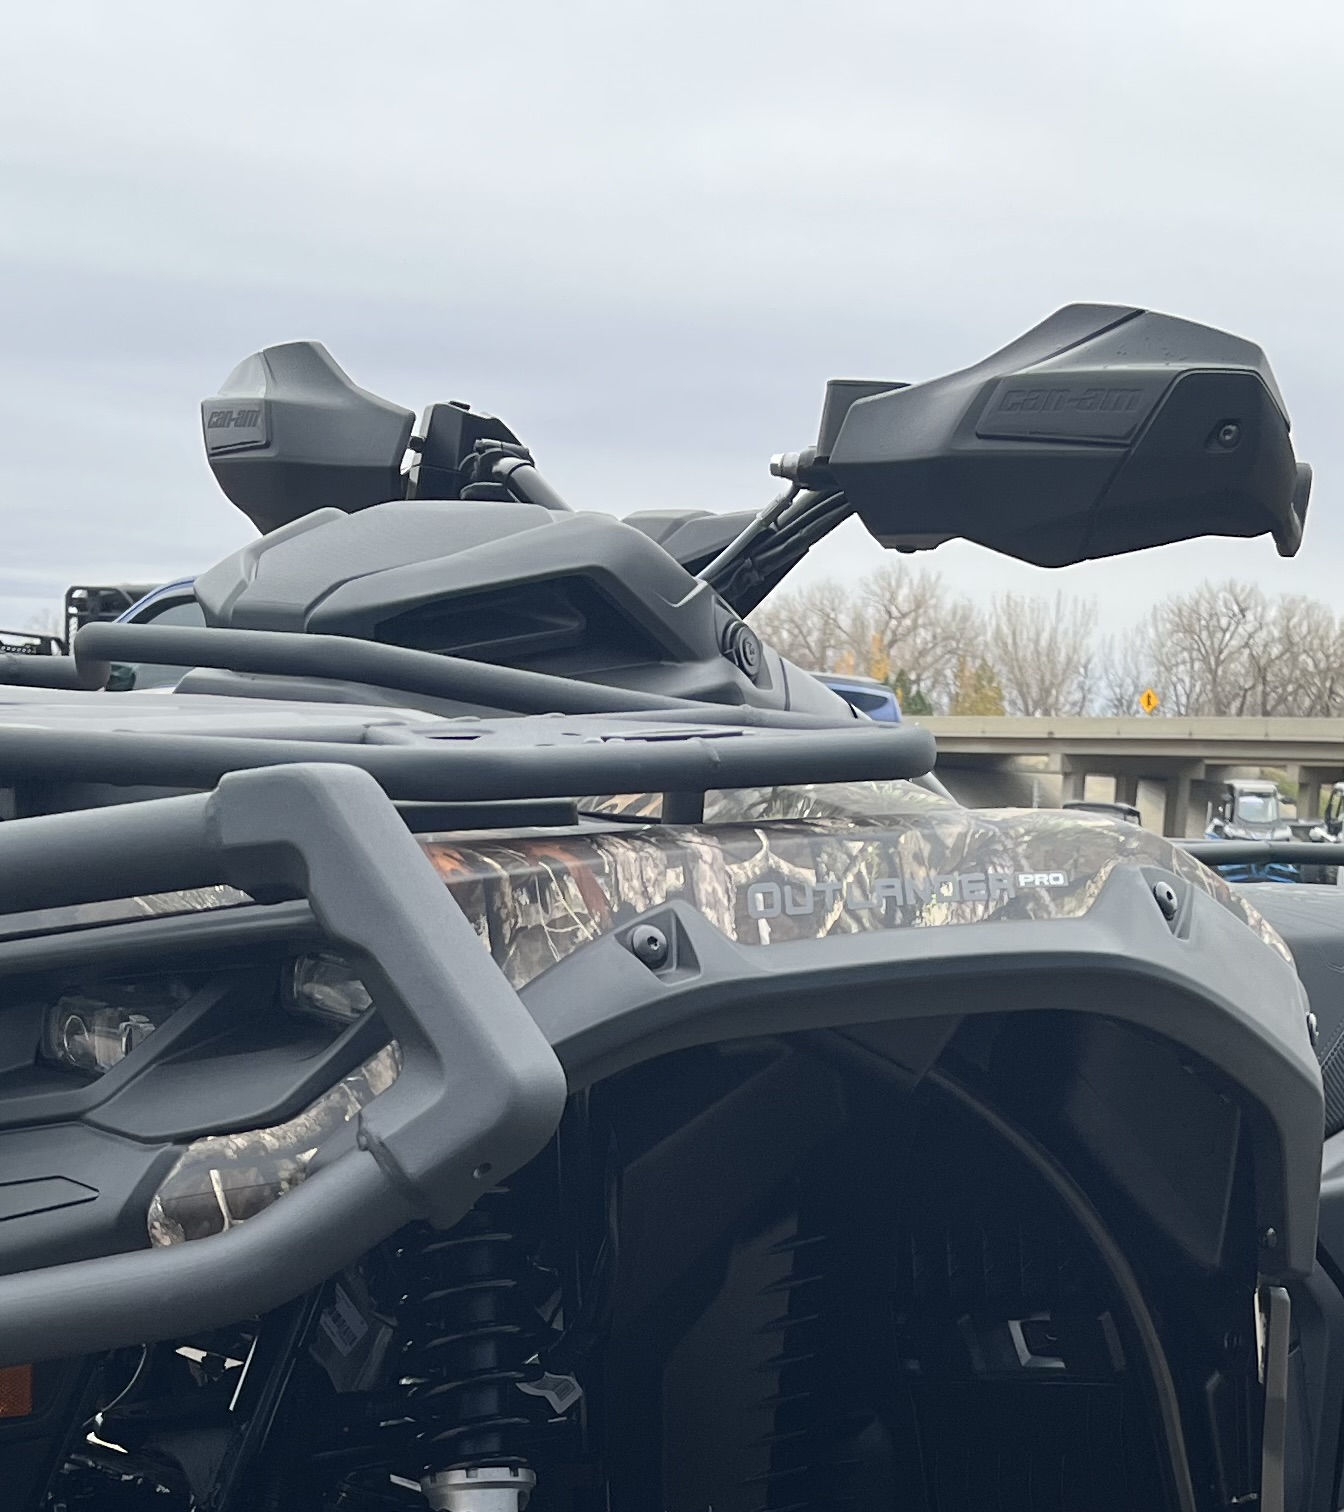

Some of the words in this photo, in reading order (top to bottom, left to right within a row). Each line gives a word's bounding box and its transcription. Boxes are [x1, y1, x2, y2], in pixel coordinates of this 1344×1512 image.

[997, 388, 1144, 413] can-am
[207, 409, 261, 429] can-am
[747, 872, 1016, 919] OUTLANDER
[1016, 871, 1066, 888] PRO
